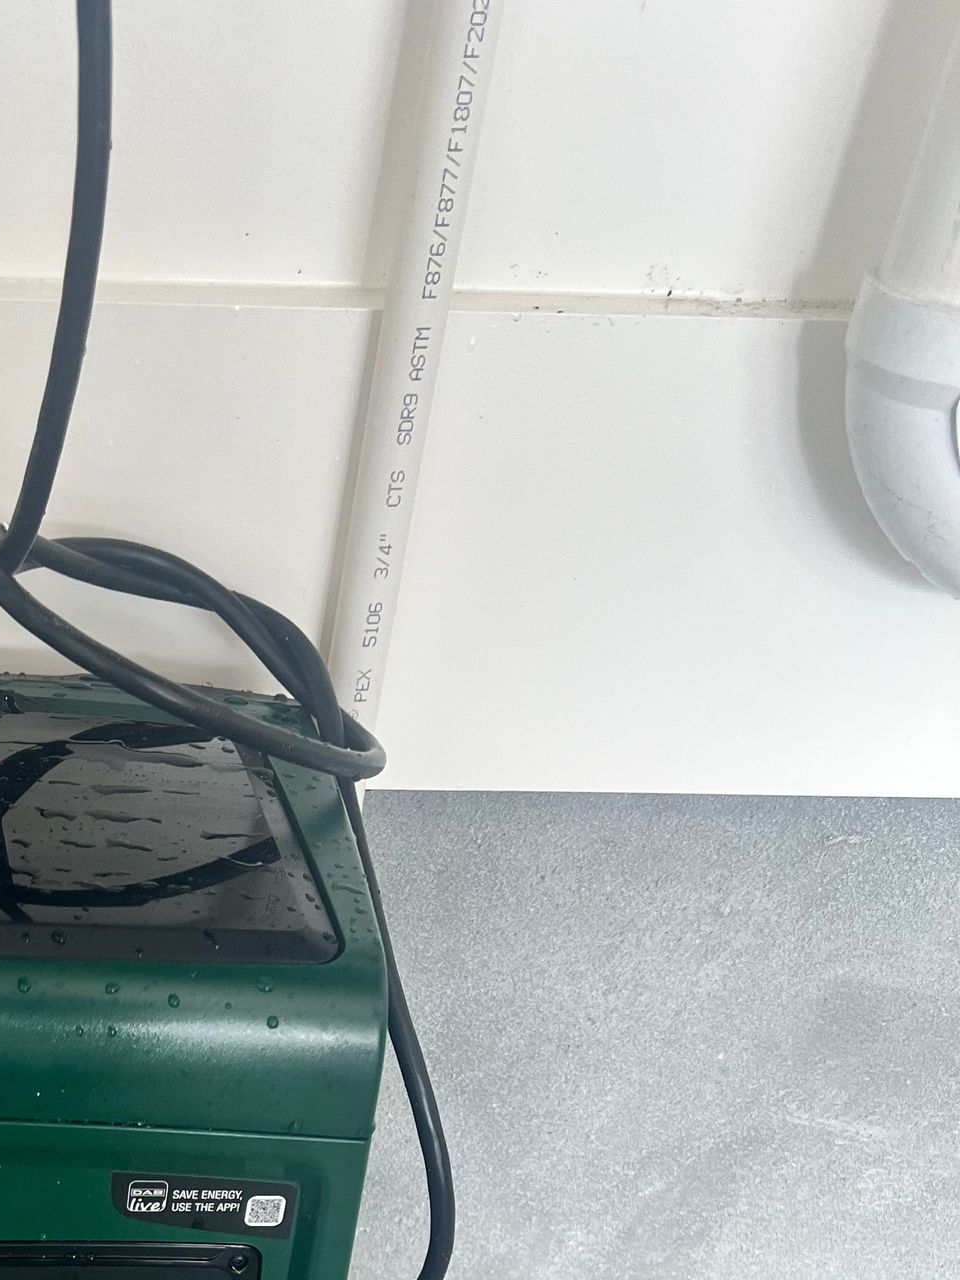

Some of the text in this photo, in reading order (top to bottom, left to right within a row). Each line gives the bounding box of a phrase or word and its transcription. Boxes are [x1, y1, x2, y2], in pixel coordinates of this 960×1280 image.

[354, 669, 372, 702] PEX
[363, 602, 383, 648] 5106
[374, 533, 392, 579] 3/4"
[385, 470, 406, 508] CTS
[396, 393, 418, 446] SDR9
[409, 326, 432, 381] ASTM
[172, 1190, 243, 1200] SAVE ENERGY,
[171, 1202, 240, 1212] USE THE APP!
